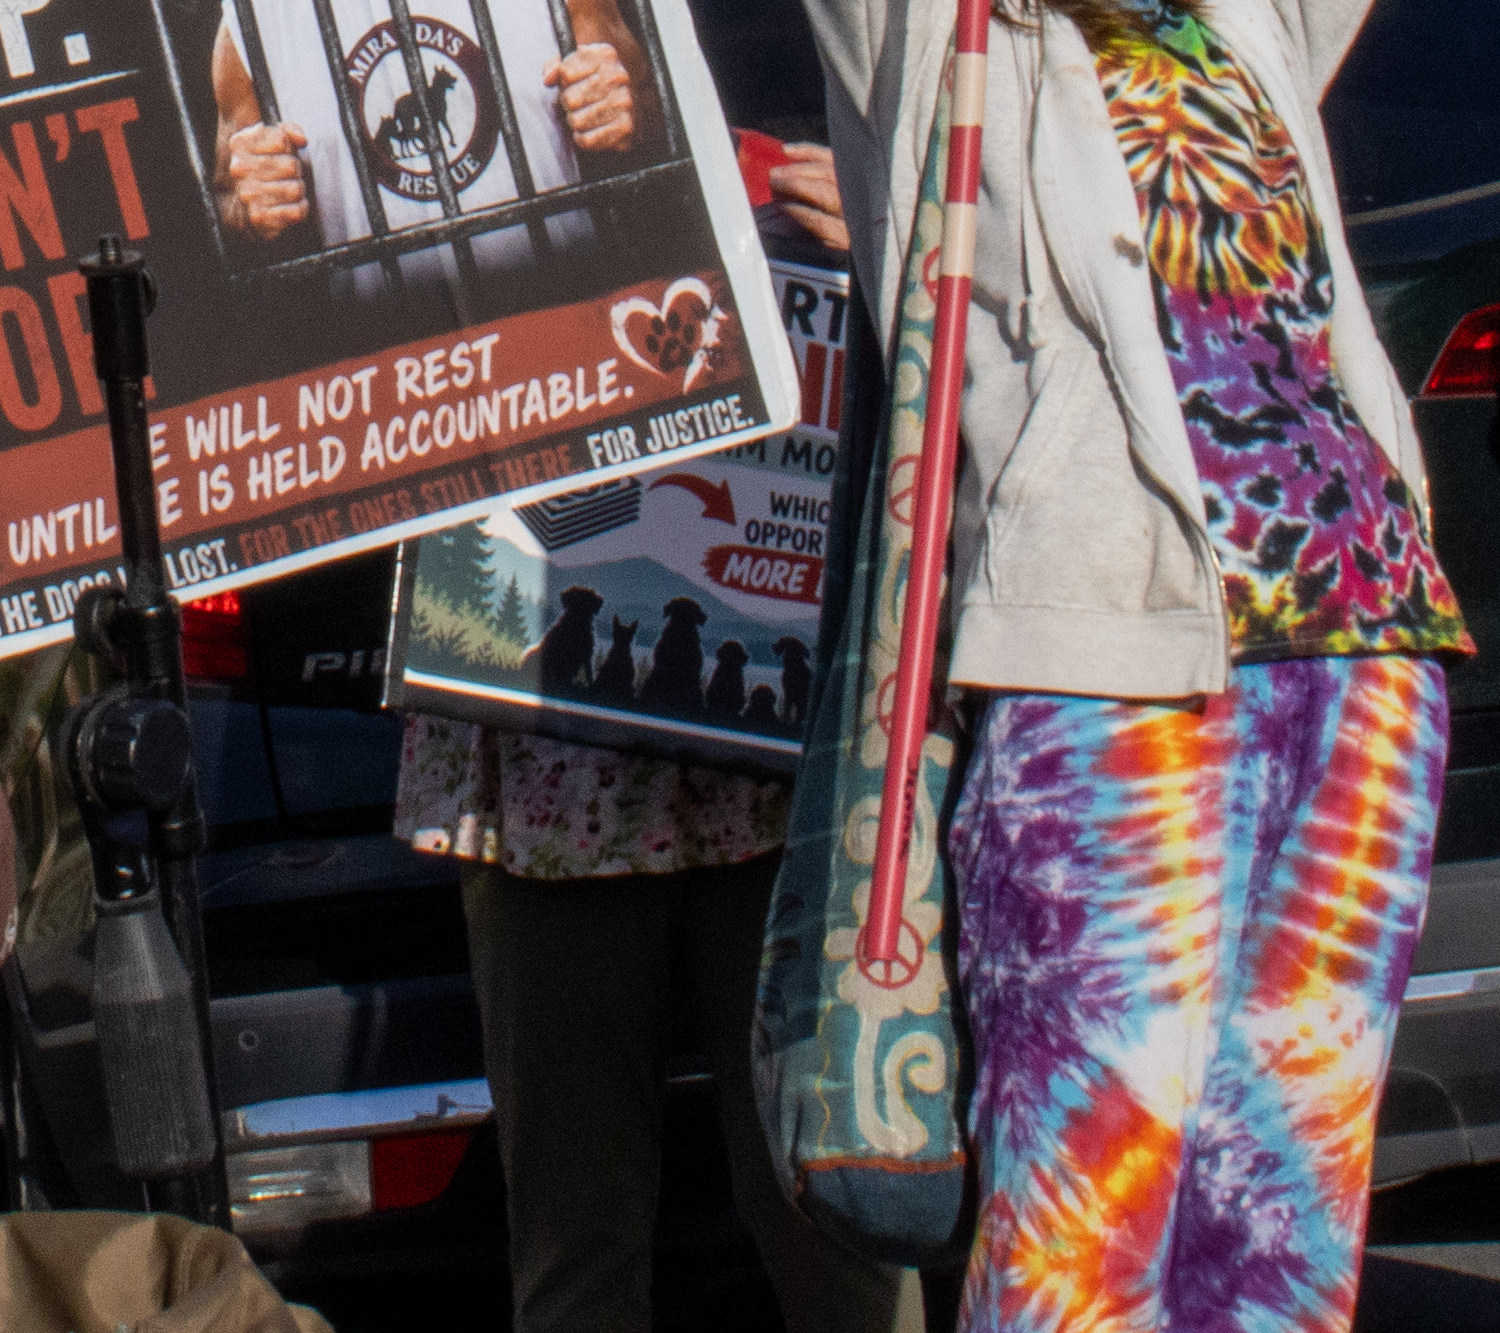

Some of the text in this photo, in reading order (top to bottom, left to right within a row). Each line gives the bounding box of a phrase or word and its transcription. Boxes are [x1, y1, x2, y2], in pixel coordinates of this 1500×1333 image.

[348, 23, 464, 83] MIRADA'S
[398, 153, 480, 195] RESUE
[186, 396, 281, 461] WILL
[299, 365, 378, 431] NOT
[394, 333, 499, 405] REST
[8, 498, 117, 565] UNTIL
[199, 463, 234, 516] IS
[247, 435, 346, 501] HELD
[361, 357, 633, 471] ACCOUNTABLE.
[165, 538, 239, 587] LOST.
[239, 525, 290, 567] FOR
[292, 508, 341, 550] THE
[350, 487, 416, 536] ONES
[420, 468, 487, 514] STILL
[586, 425, 641, 469] FOR
[647, 394, 755, 455] JUSTICE.
[769, 490, 831, 524] WHIC
[745, 519, 824, 555] OPPOR
[721, 552, 810, 596] MORE
